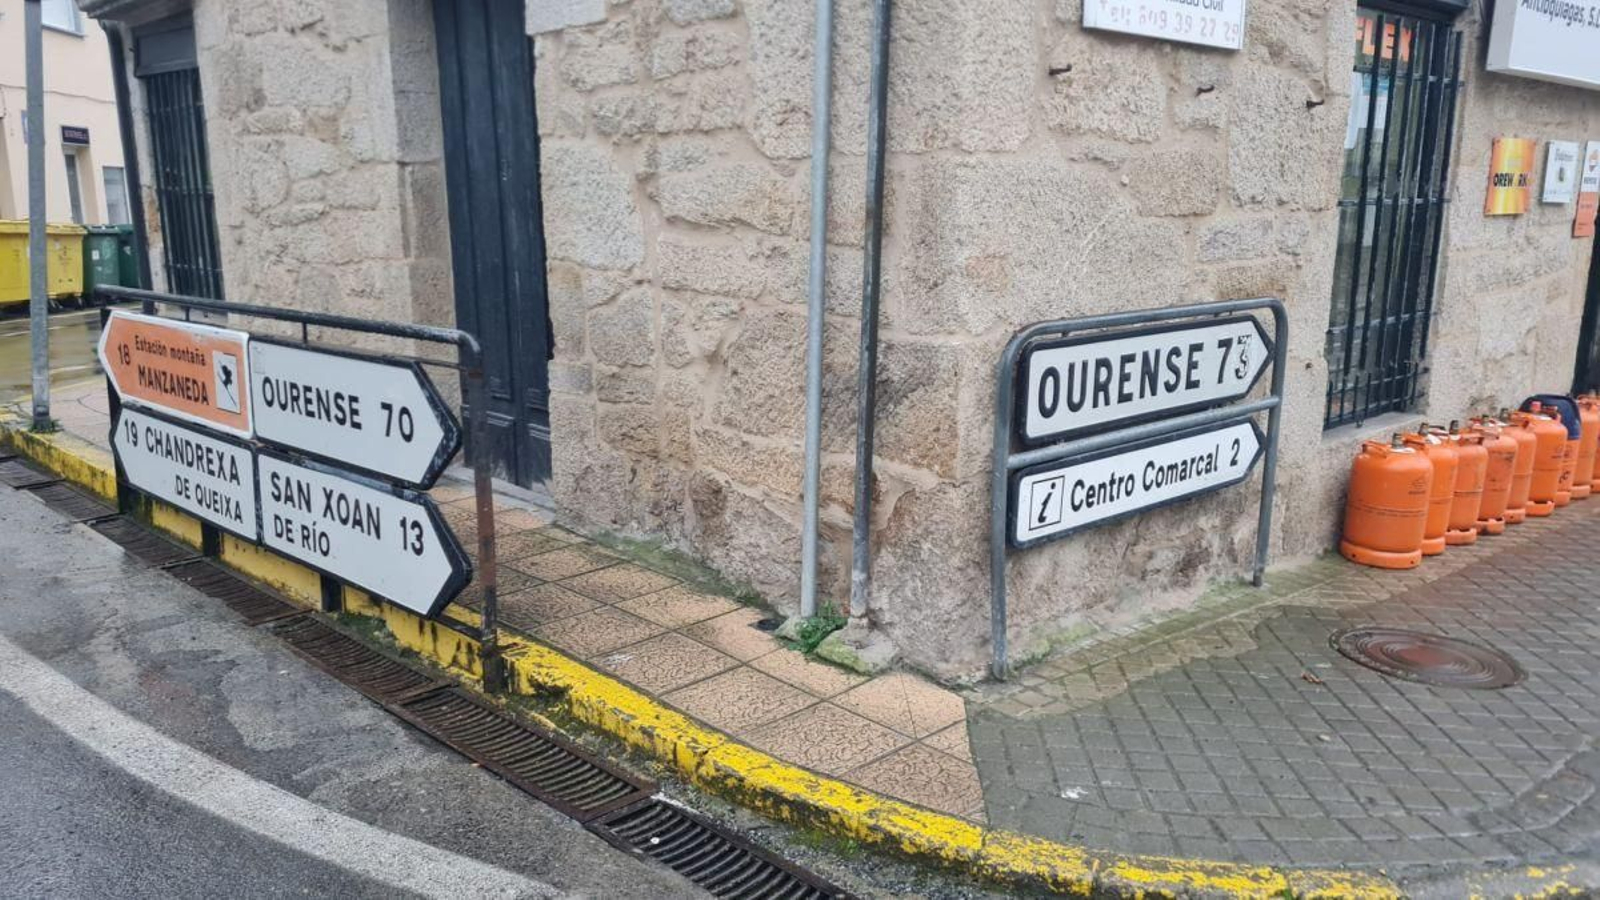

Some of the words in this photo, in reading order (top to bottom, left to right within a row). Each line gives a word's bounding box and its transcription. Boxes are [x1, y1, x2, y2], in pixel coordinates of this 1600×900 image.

[1174, 12, 1193, 33] 39
[117, 342, 131, 365] 18
[134, 335, 168, 357] Estación
[170, 347, 206, 366] montaña
[138, 364, 209, 405] MANZANEDA
[1038, 342, 1204, 419] OURENSE
[262, 376, 362, 430] OURENSE
[380, 401, 414, 443] 70
[124, 418, 138, 447] 19
[145, 426, 240, 486] CHANDREXA
[1070, 471, 1135, 512] Centro
[1142, 444, 1219, 491] Comarcal
[1229, 438, 1241, 467] 2
[175, 474, 191, 500] DE
[195, 483, 243, 524] QUEIXA
[270, 471, 312, 513] SAN
[322, 486, 381, 540] XOAN
[400, 516, 424, 556] 13
[274, 514, 295, 544] DE
[301, 521, 330, 557] RÍO
